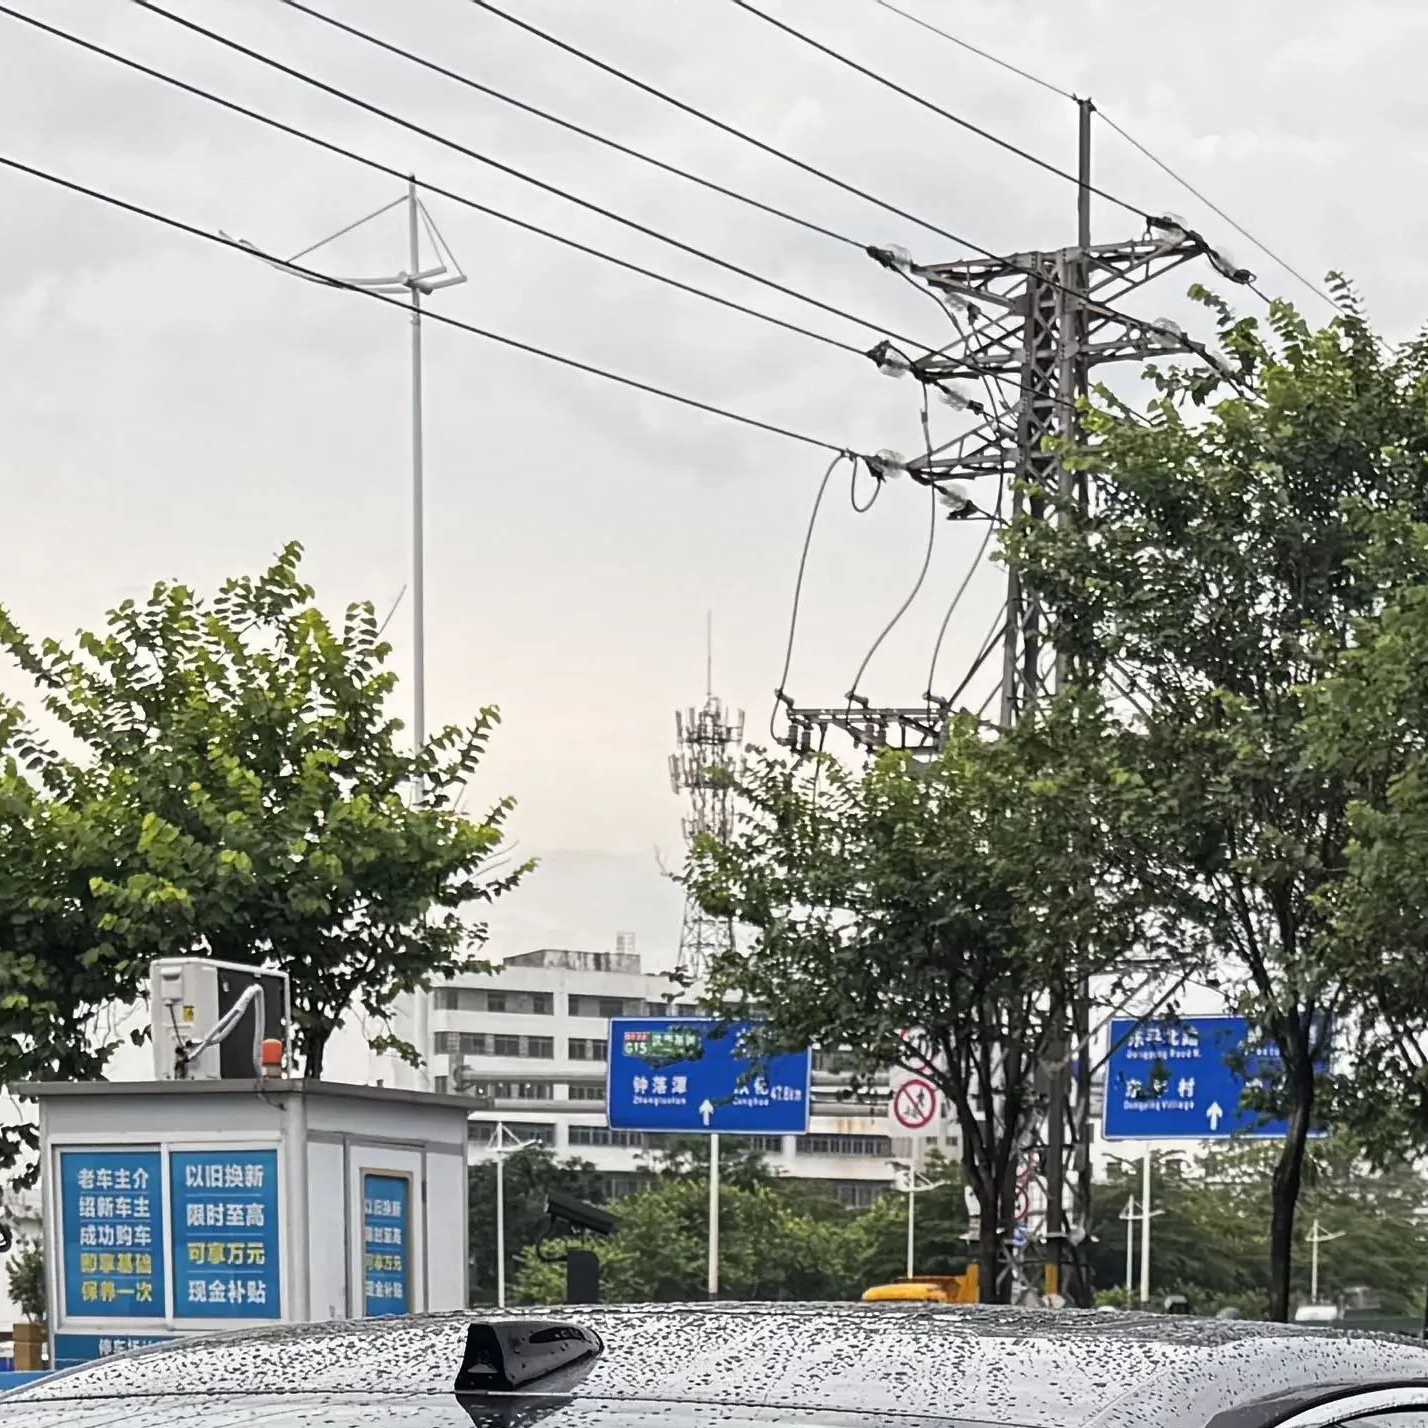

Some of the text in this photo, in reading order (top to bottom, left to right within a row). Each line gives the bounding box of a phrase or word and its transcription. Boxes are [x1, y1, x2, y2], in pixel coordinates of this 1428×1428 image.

[77, 1168, 149, 1190] 老车主介
[185, 1164, 264, 1188] 以旧换新
[79, 1196, 151, 1218] 绍新车主
[186, 1203, 265, 1227] 限时至高
[80, 1225, 152, 1246] 成功购车
[187, 1242, 265, 1265] 可享万元
[81, 1281, 153, 1302] 保养一次
[188, 1280, 266, 1304] 现金补贴
